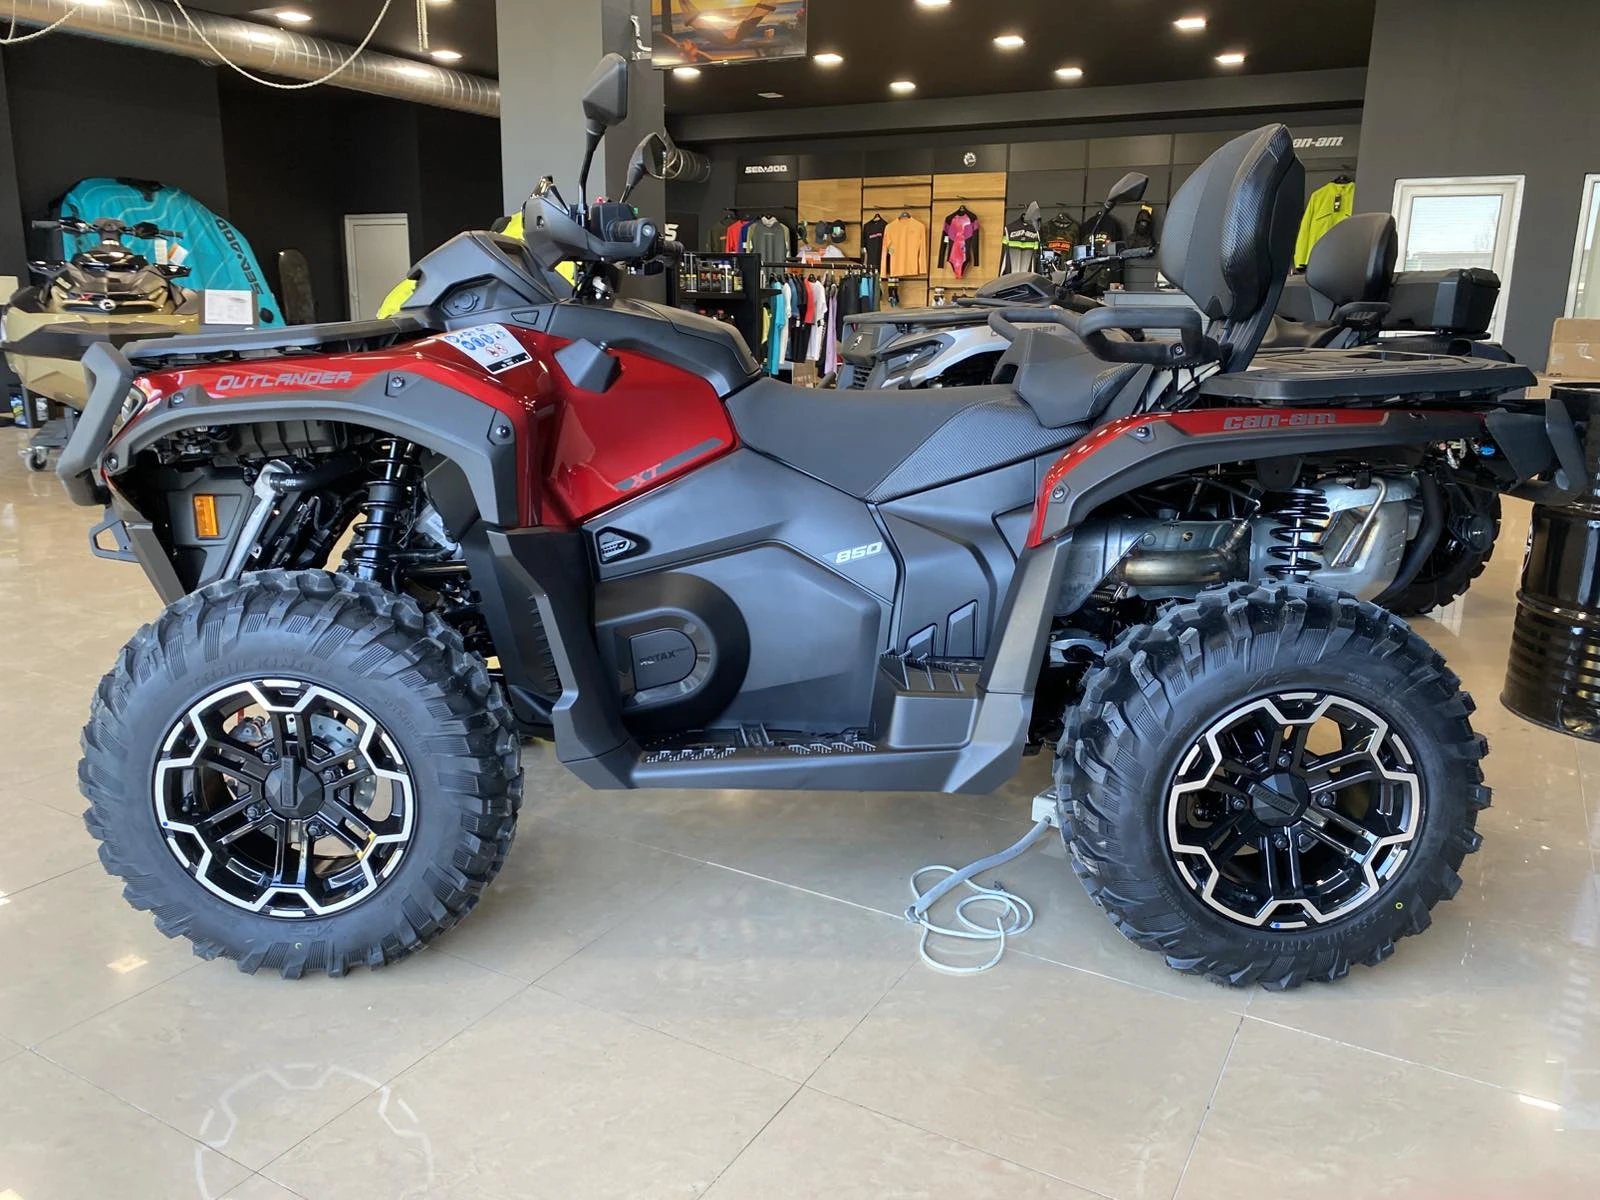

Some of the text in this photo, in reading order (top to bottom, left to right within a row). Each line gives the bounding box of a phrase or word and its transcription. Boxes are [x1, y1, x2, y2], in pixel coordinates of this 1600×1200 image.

[1293, 136, 1343, 148] an-am
[215, 371, 352, 390] OUTLANDER
[1223, 412, 1336, 430] can-am
[631, 463, 661, 488] XT
[835, 541, 882, 563] 850
